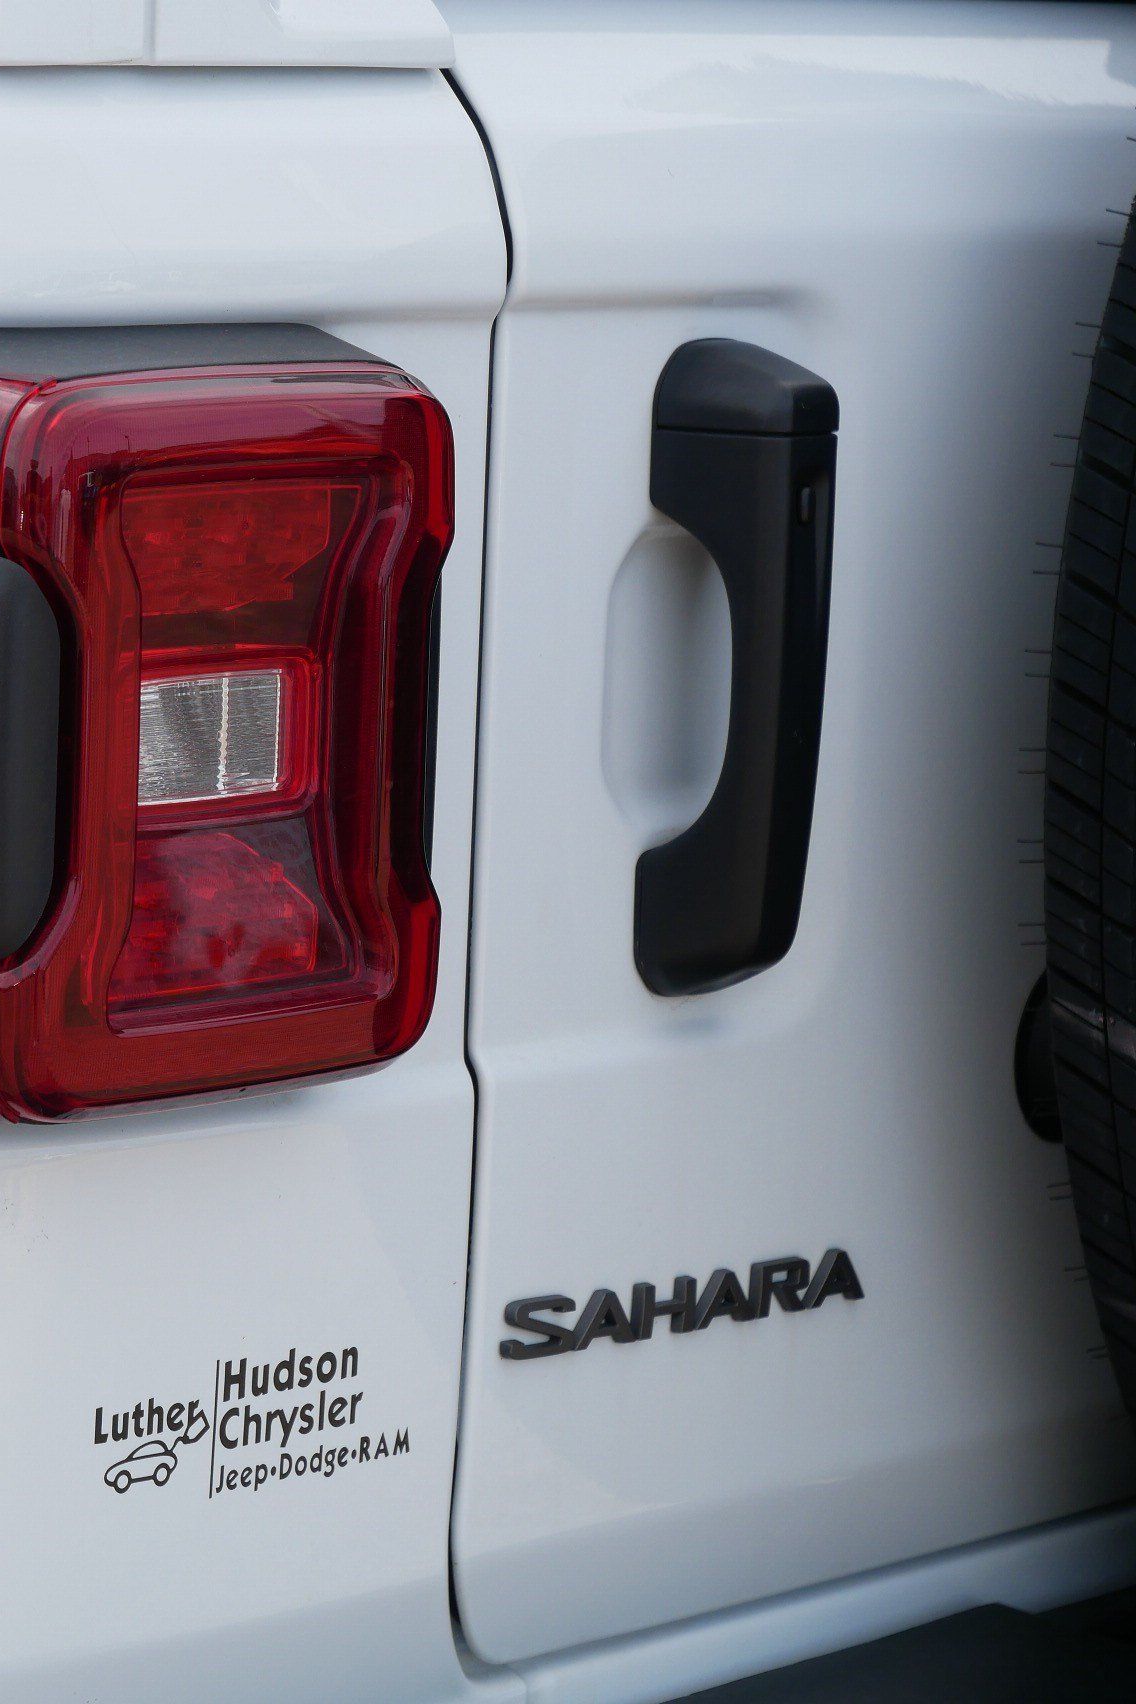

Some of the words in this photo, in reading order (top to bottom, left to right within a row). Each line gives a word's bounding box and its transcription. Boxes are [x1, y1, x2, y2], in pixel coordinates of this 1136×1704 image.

[499, 1248, 864, 1360] SAHARA
[223, 1346, 359, 1402] Hudson
[94, 1398, 201, 1444] Luther
[219, 1390, 363, 1449] Chrysler
